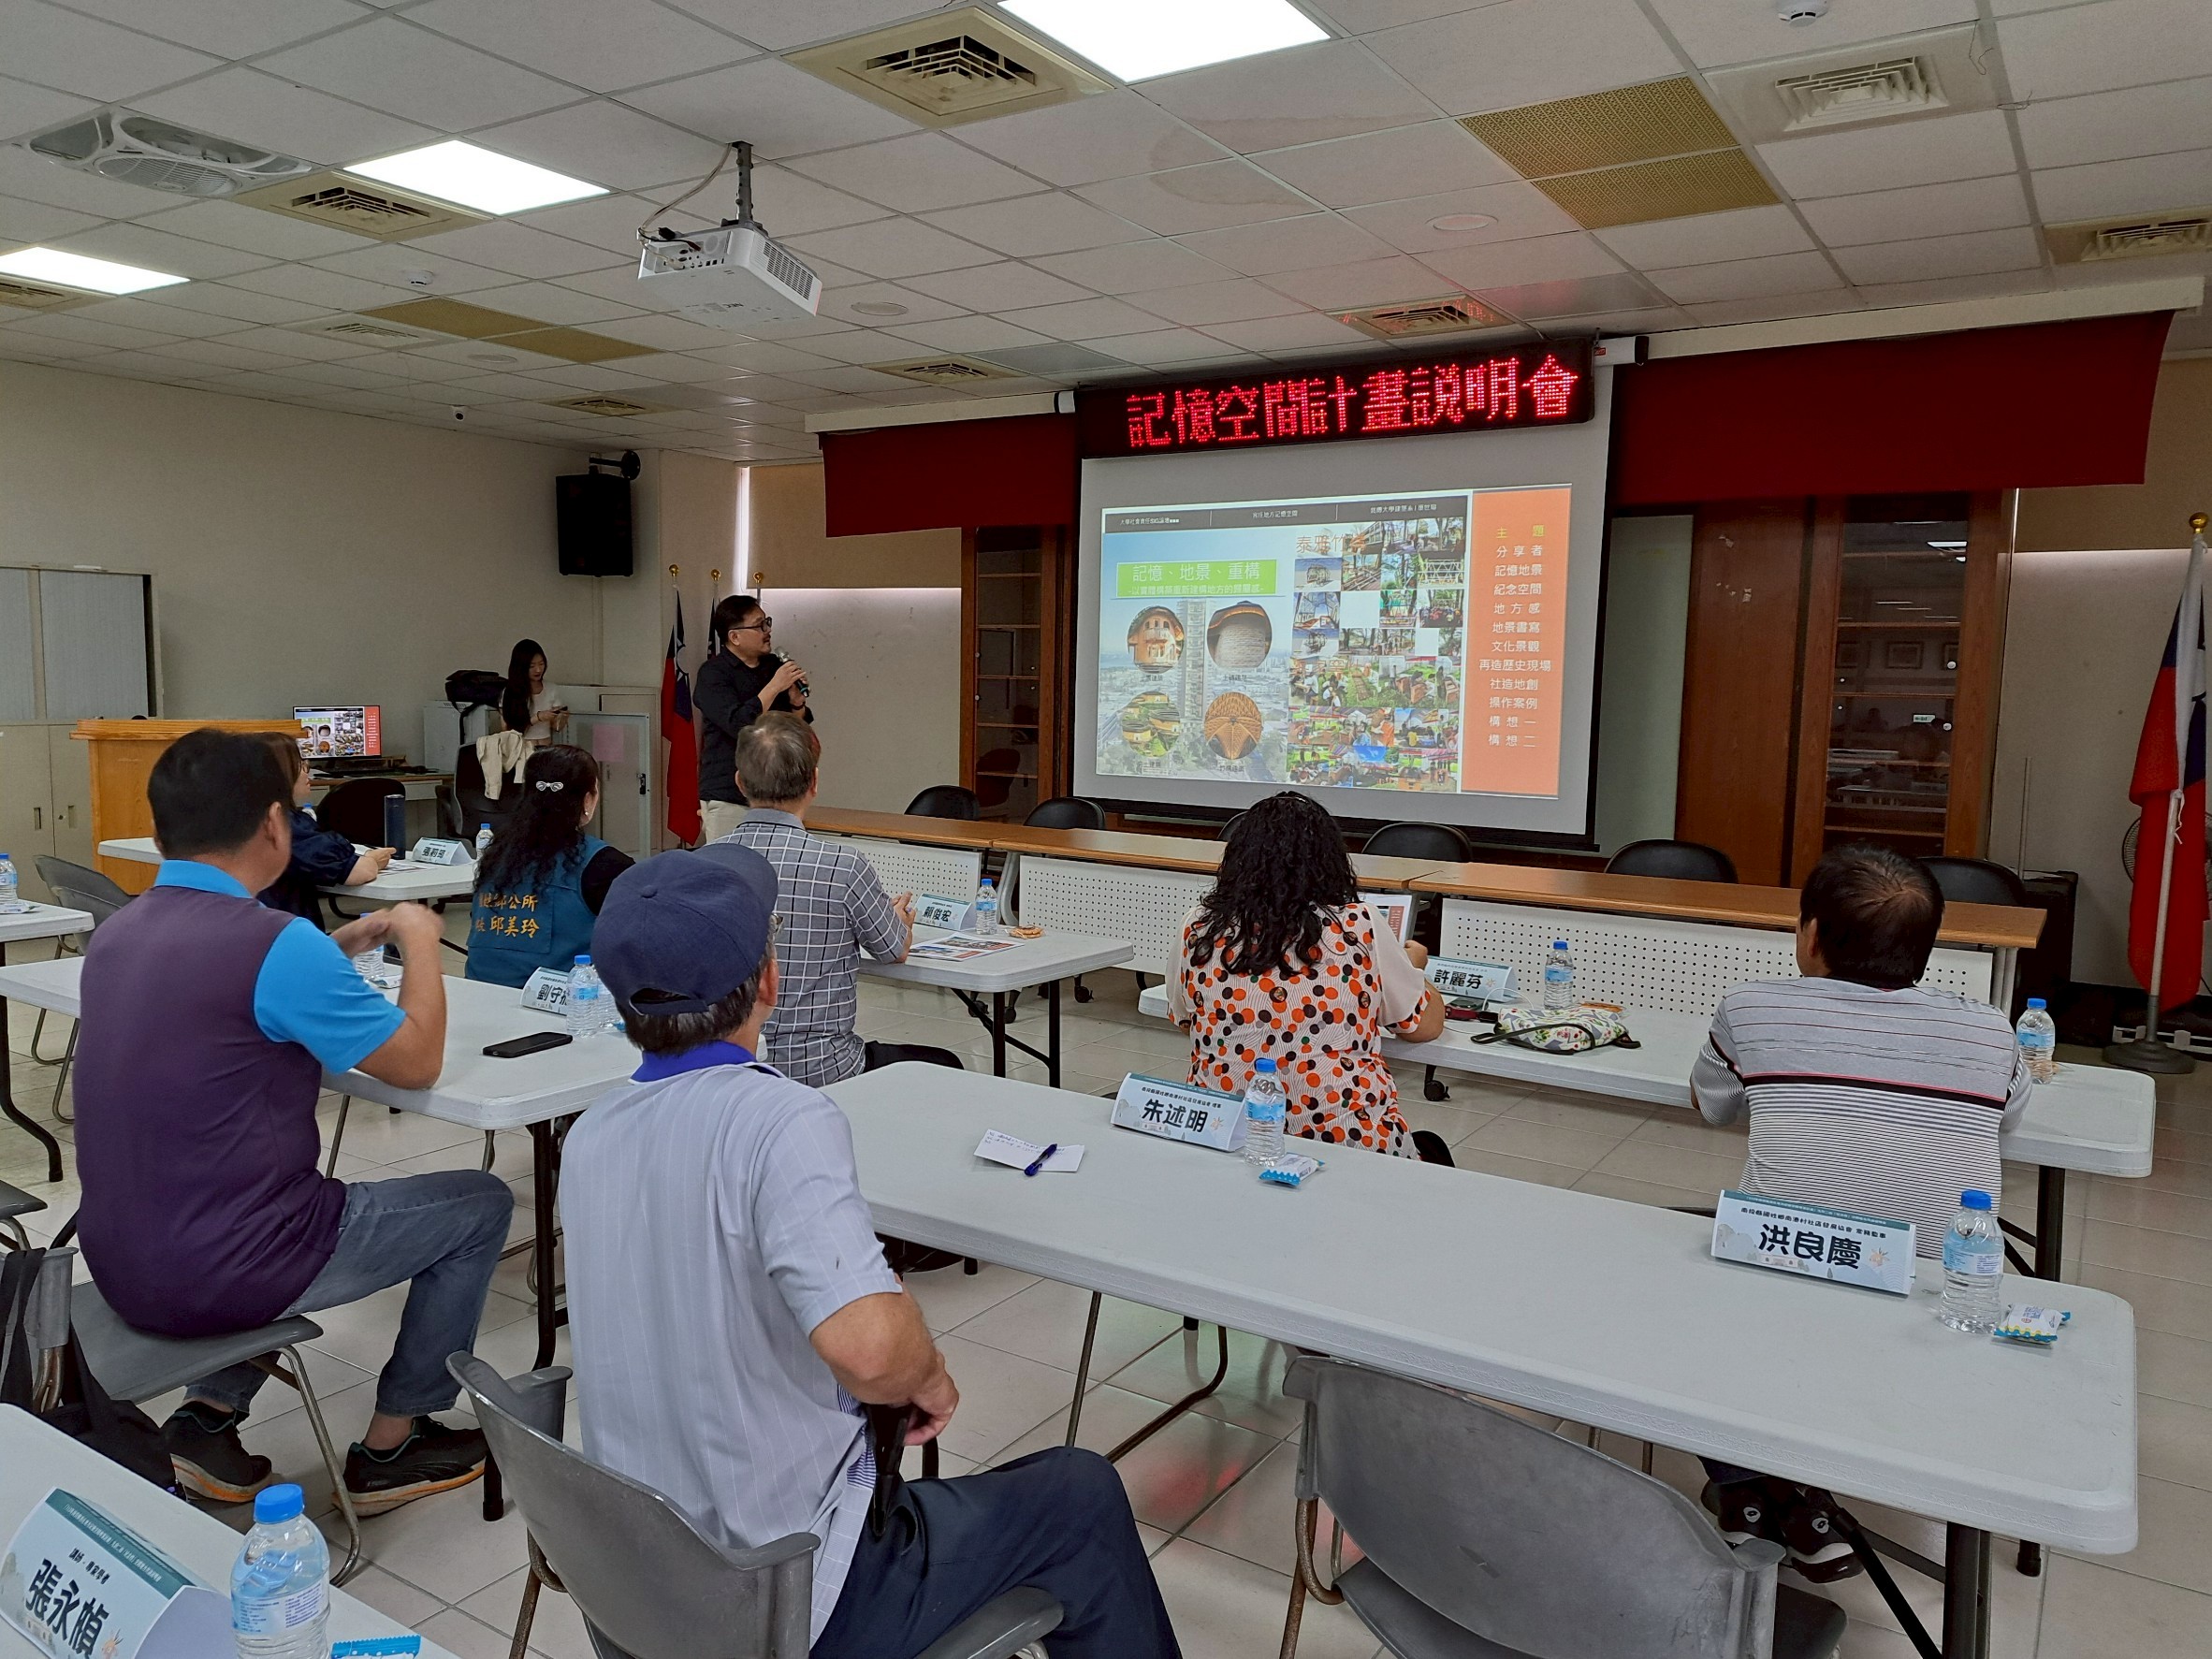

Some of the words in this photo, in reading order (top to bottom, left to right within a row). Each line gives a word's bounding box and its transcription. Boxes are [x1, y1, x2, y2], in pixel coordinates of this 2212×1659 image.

[1496, 545, 1542, 558] 分享者
[1133, 562, 1260, 582] 記憶、地景、重構
[1494, 564, 1542, 576] 記憶地景
[1493, 583, 1542, 595] 紀念空間
[1493, 603, 1541, 615] 地方感
[1492, 621, 1540, 633] 地景書寫
[1491, 640, 1540, 652] 文化景觀
[1478, 659, 1551, 672] 再造歷史現場
[1490, 678, 1538, 691] 社造地創
[1489, 697, 1537, 709] 操作案例
[1489, 716, 1536, 728] 構想一
[1488, 734, 1536, 748] 構想二
[490, 916, 539, 938] 邱美玲
[1434, 969, 1482, 989] 許麗芬
[1142, 1098, 1209, 1134] 朱述明
[1758, 1223, 1862, 1271] 洪良慶
